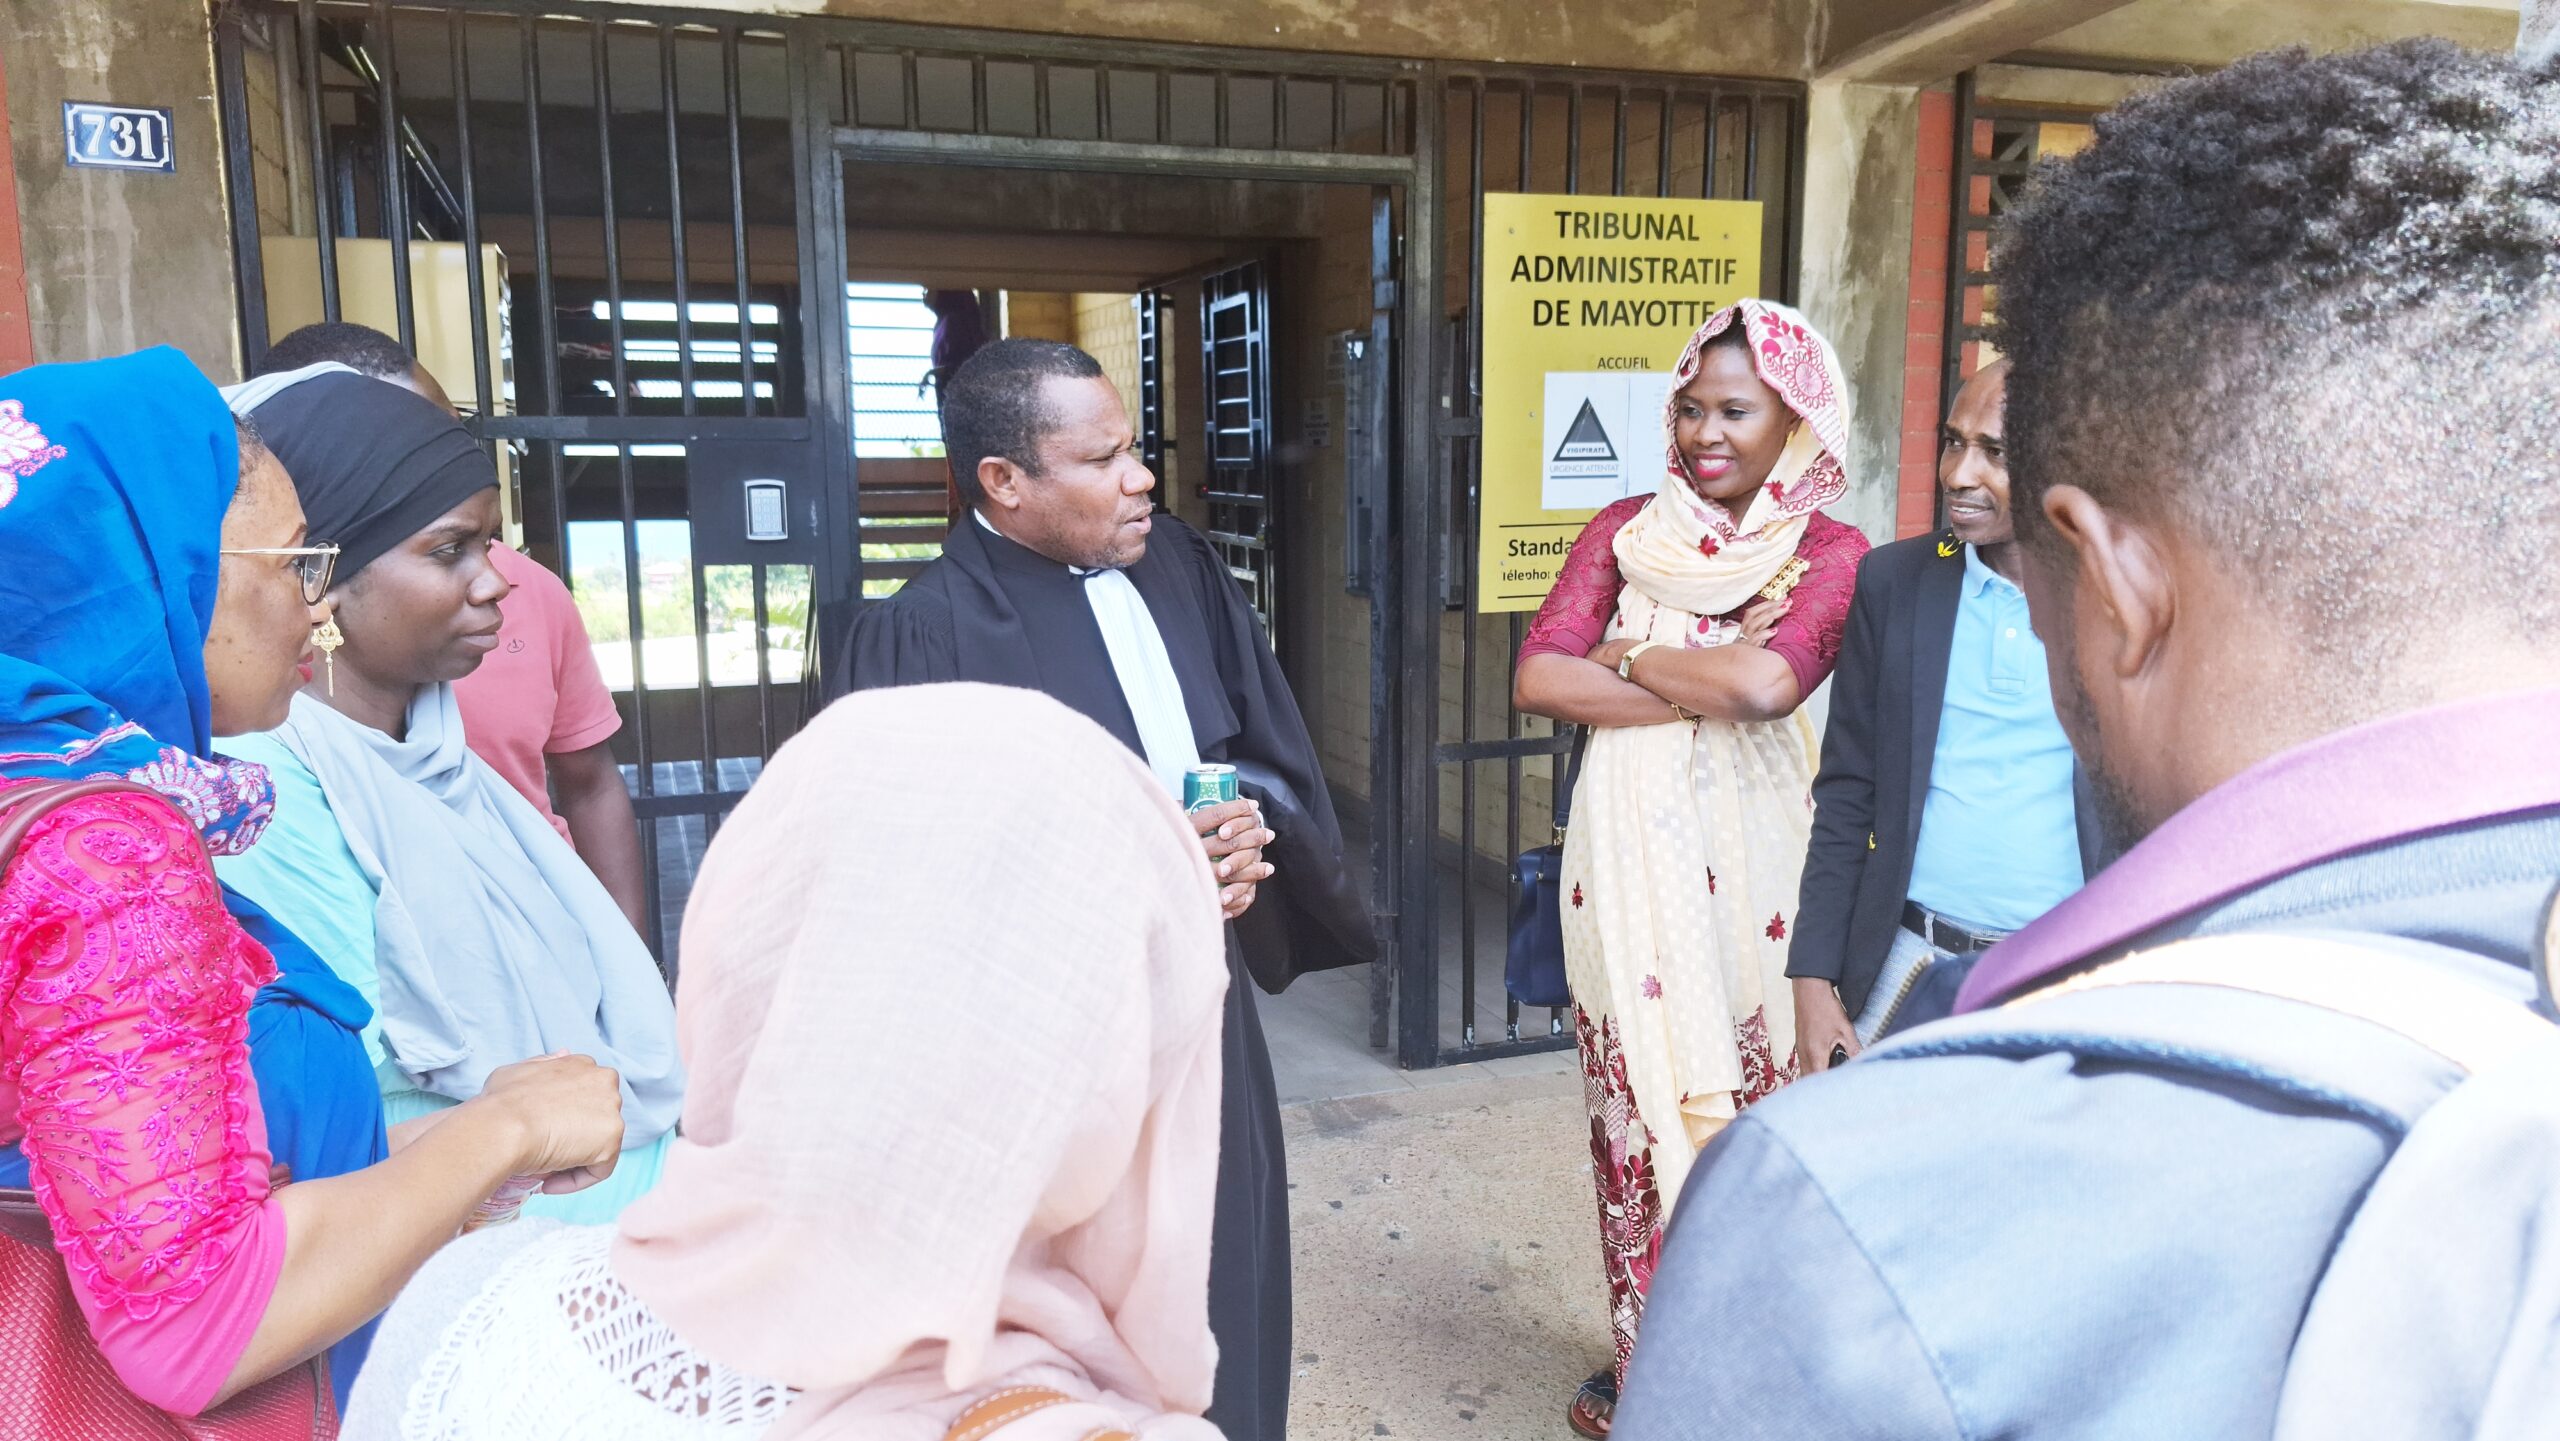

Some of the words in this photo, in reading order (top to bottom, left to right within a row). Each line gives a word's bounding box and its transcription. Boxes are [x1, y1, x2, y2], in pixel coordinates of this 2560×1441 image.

[81, 113, 156, 159] 731
[1554, 210, 1700, 242] TRIBUNAL
[1510, 254, 1737, 285] ADMINISTRATIF
[1532, 299, 1570, 327] DE
[1580, 299, 1716, 327] MAYOTTE
[1549, 463, 1584, 474] URGENCE
[1585, 463, 1619, 474] ATTENTAT
